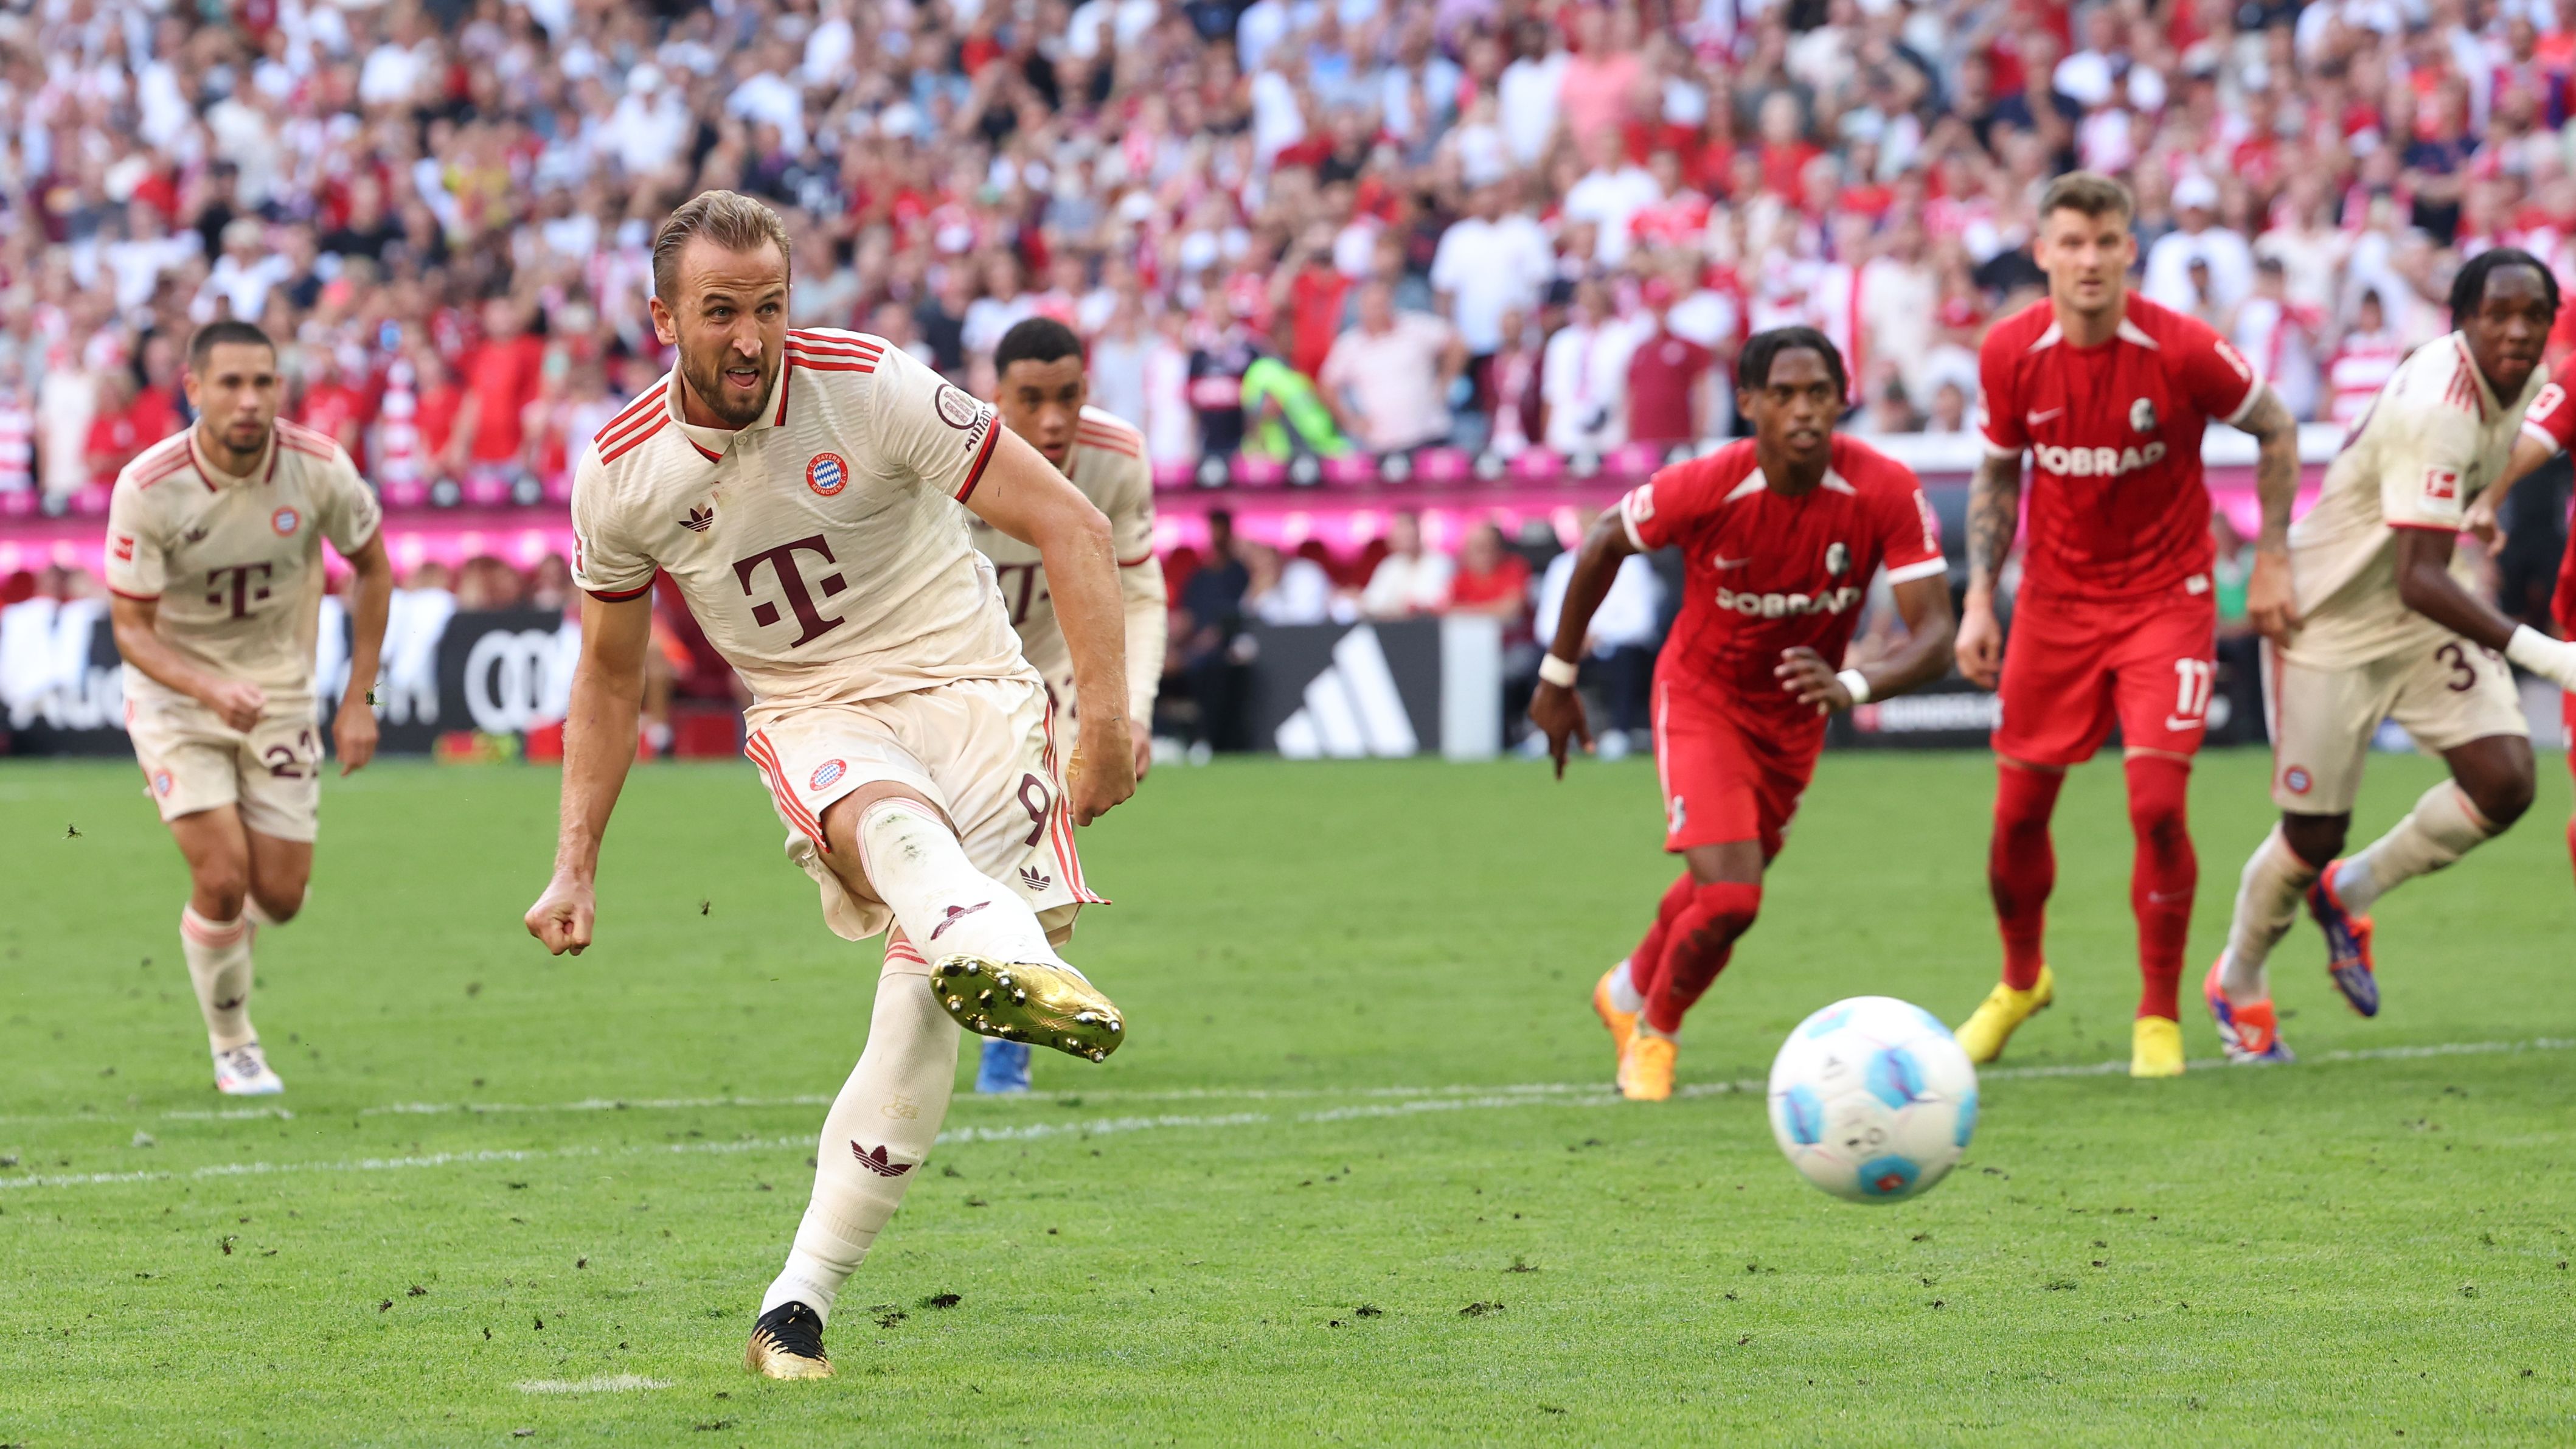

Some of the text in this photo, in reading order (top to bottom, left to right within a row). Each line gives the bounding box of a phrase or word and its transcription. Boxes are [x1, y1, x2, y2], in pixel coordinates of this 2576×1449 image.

[816, 454, 841, 464] BAYERN
[965, 406, 992, 452] Allian
[732, 533, 847, 648] T
[1018, 773, 1051, 847] 9
